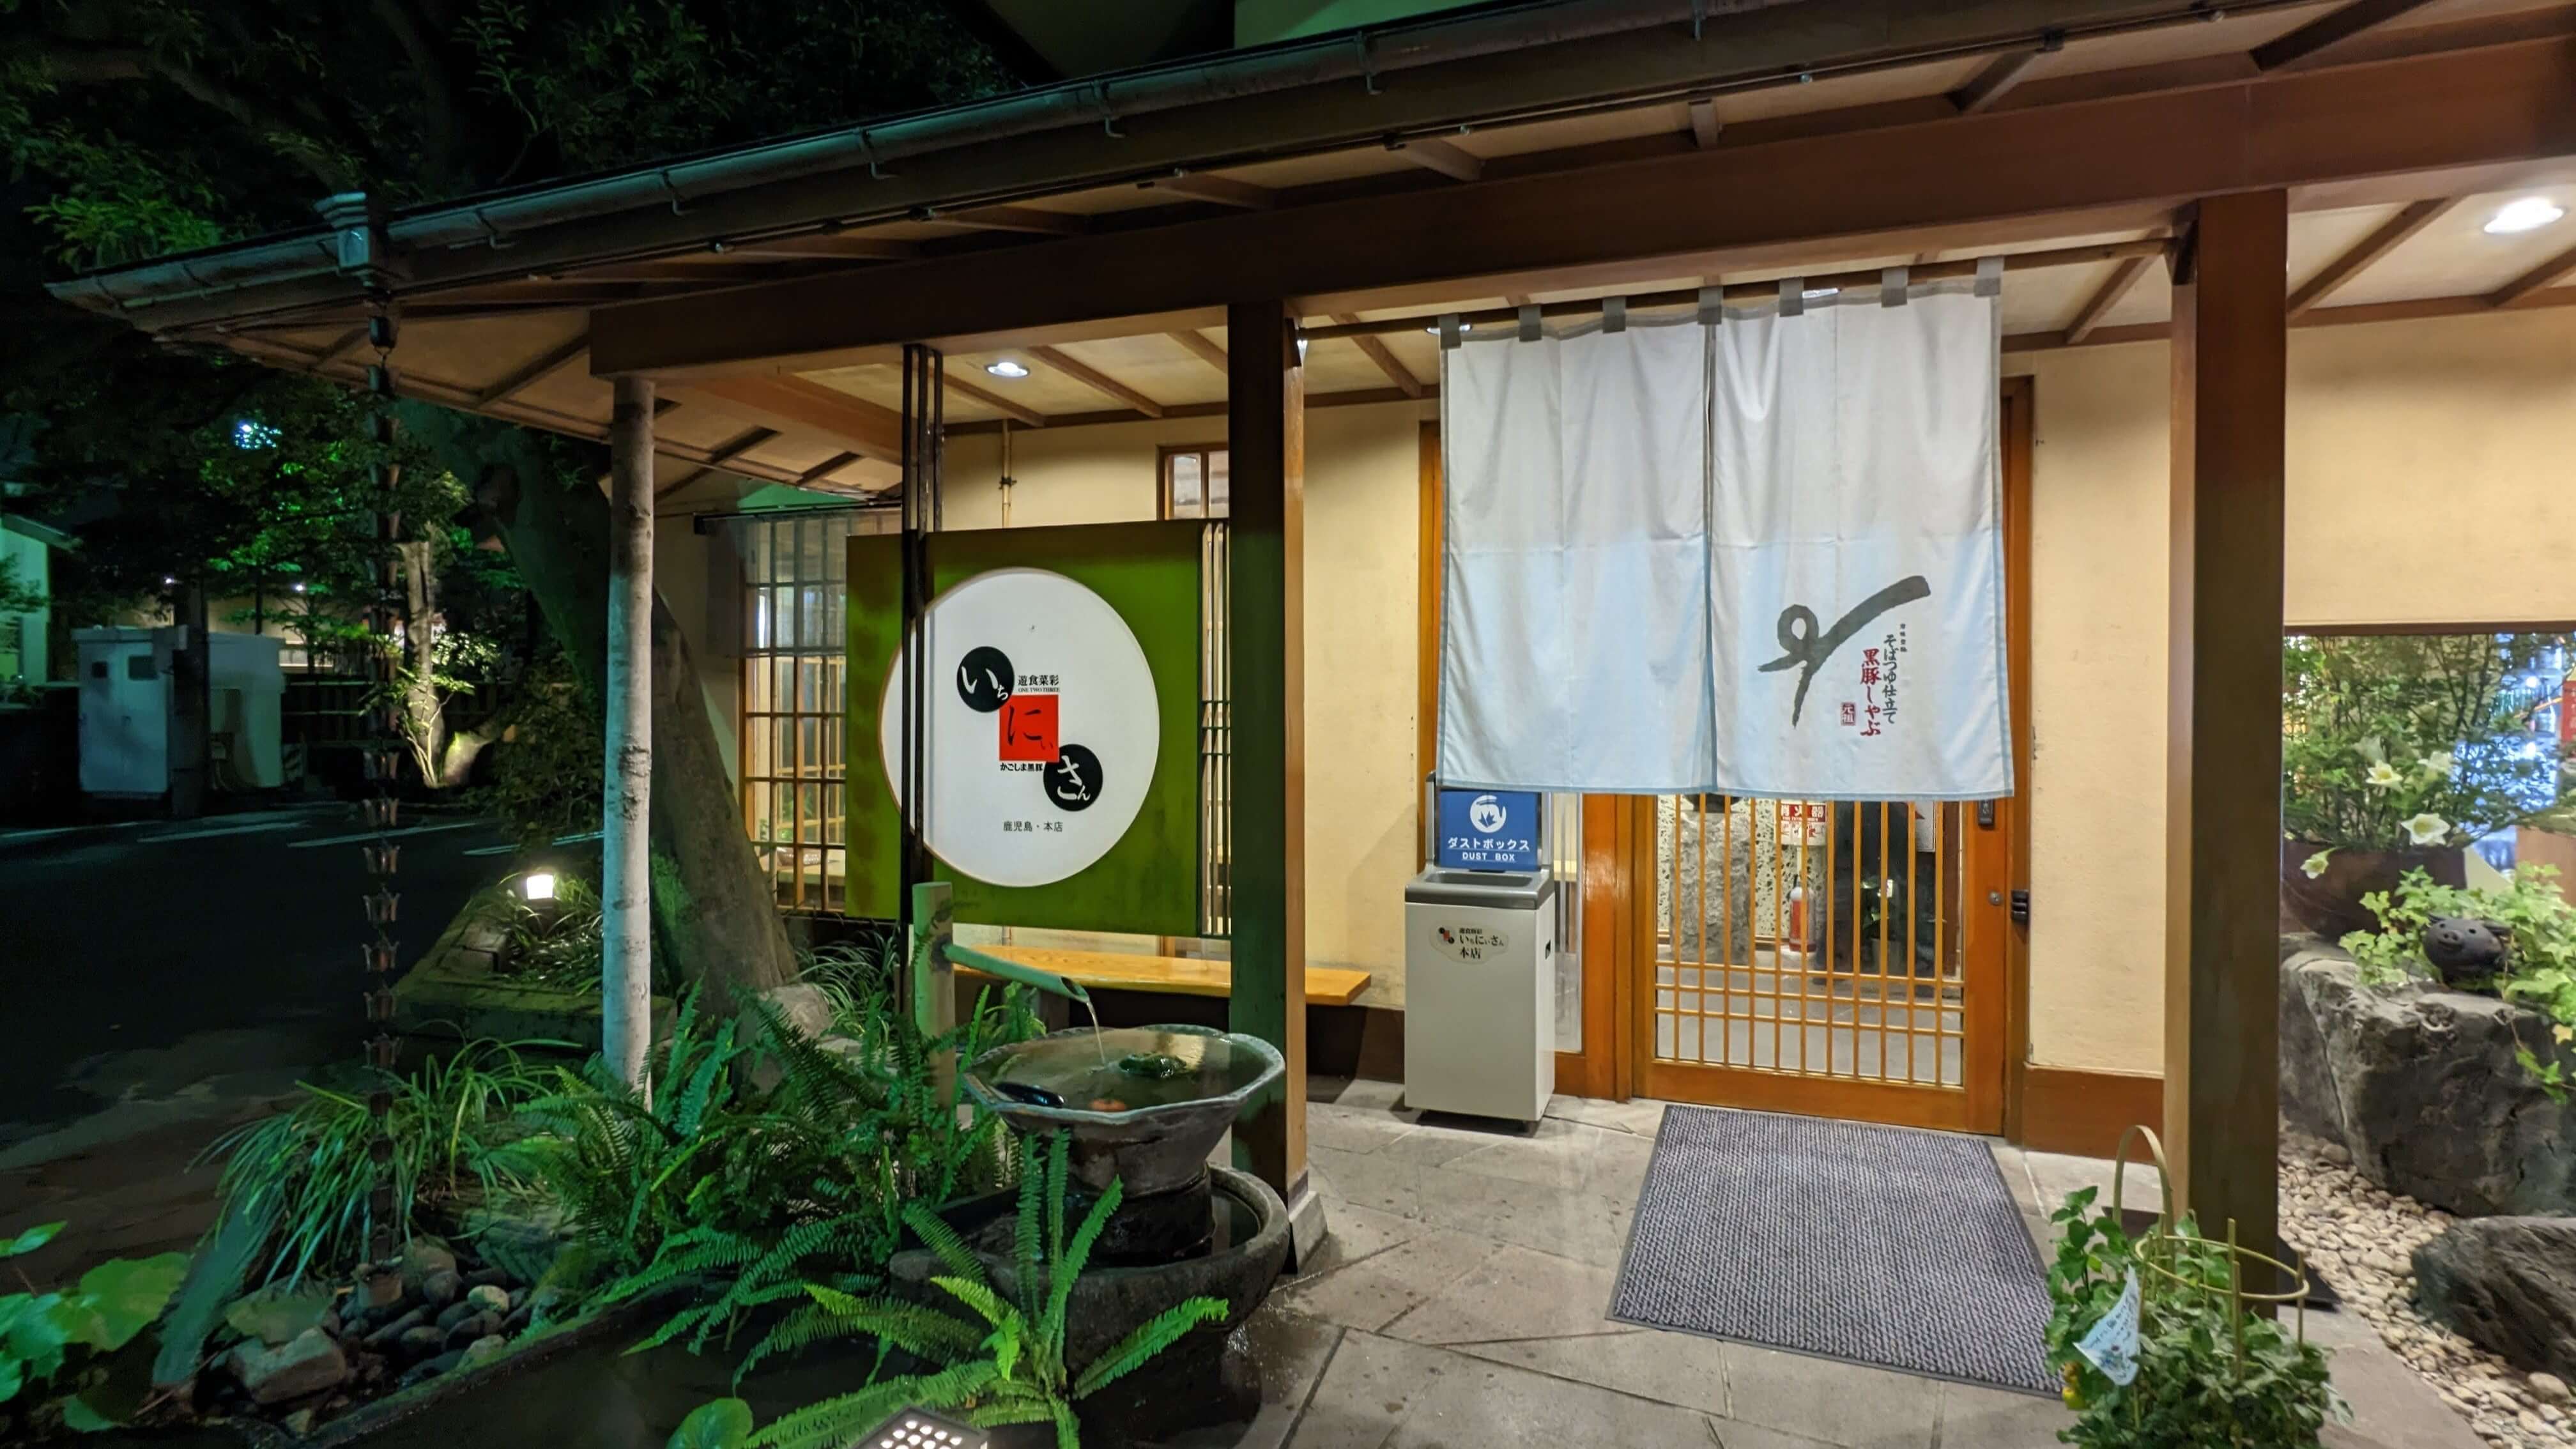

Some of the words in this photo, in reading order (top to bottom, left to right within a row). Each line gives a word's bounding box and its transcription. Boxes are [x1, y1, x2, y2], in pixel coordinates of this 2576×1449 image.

[1882, 634, 1898, 724] そばつゆ仕立て
[1447, 836, 1530, 850] ダストボックス
[1462, 852, 1488, 861] DUST
[1495, 853, 1516, 862] BOX
